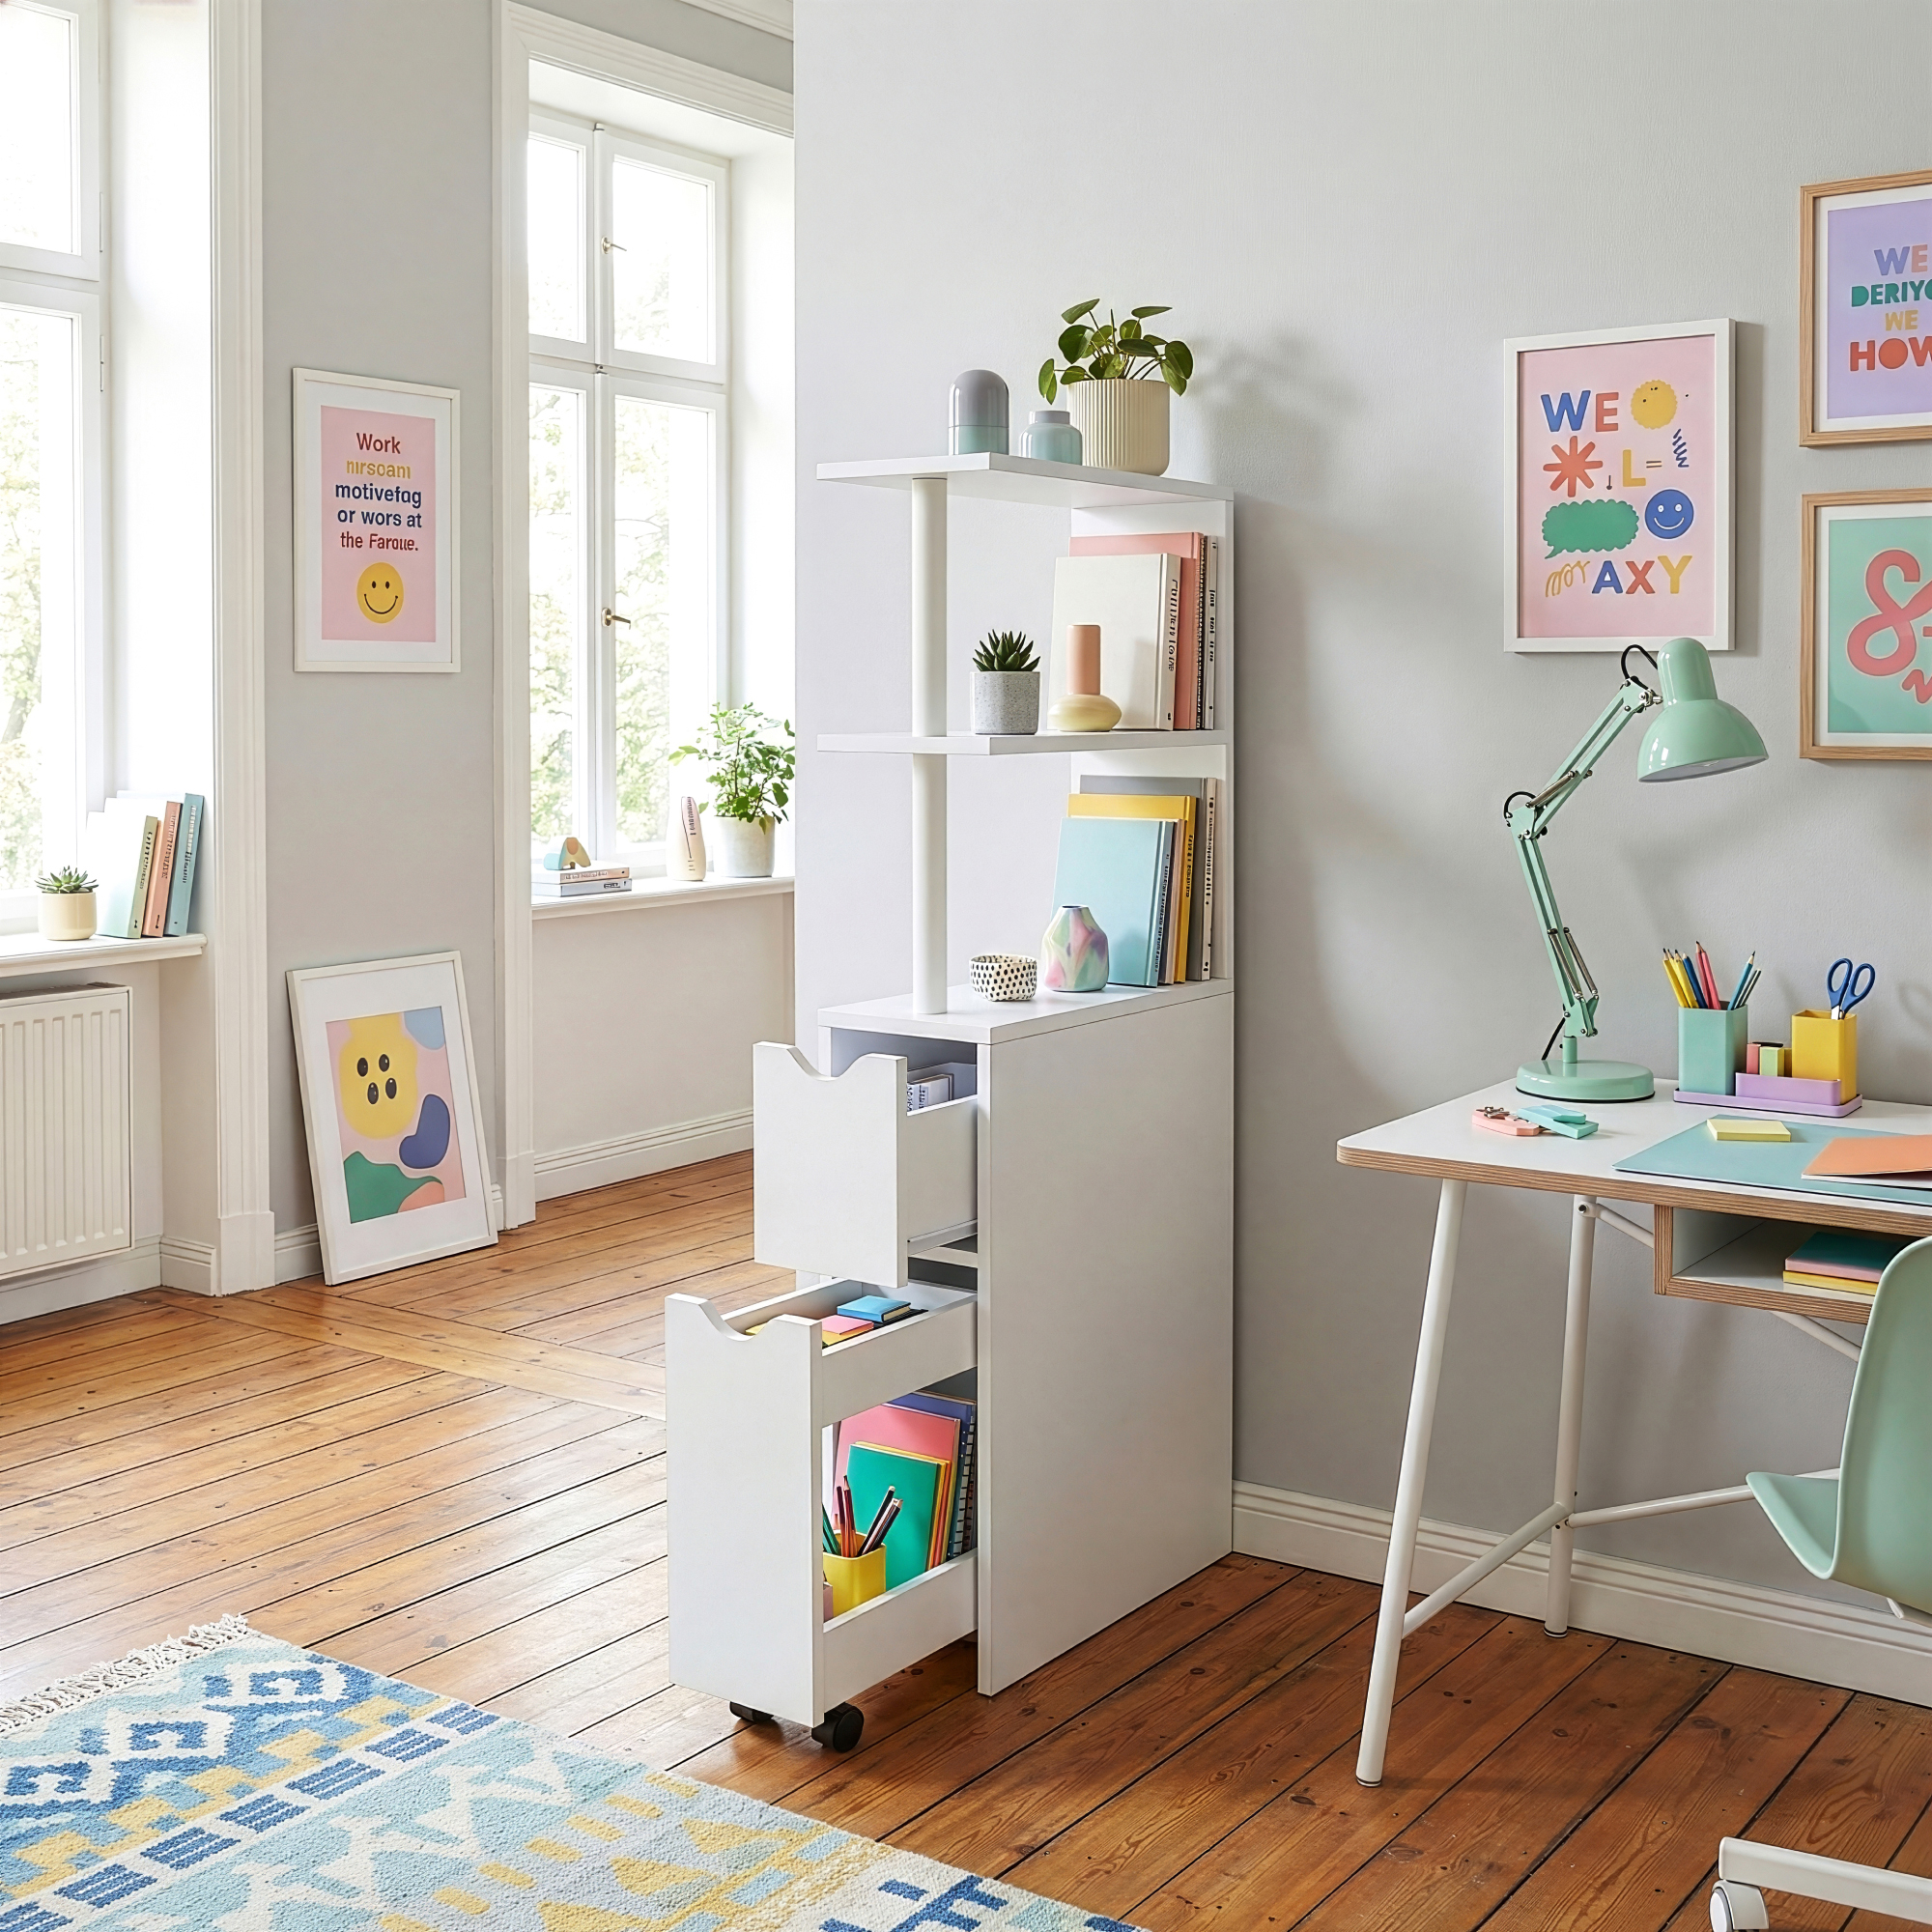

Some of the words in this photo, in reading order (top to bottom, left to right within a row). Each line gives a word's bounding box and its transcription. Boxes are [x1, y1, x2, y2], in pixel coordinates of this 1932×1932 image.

[1874, 244, 1928, 276] WE
[1885, 309, 1918, 331] WE
[1541, 389, 1619, 433] WE
[356, 432, 401, 454] Work
[337, 509, 356, 524] or
[360, 510, 402, 526] wors
[407, 513, 422, 528] at
[340, 530, 363, 549] the
[1591, 554, 1693, 595] AXY
